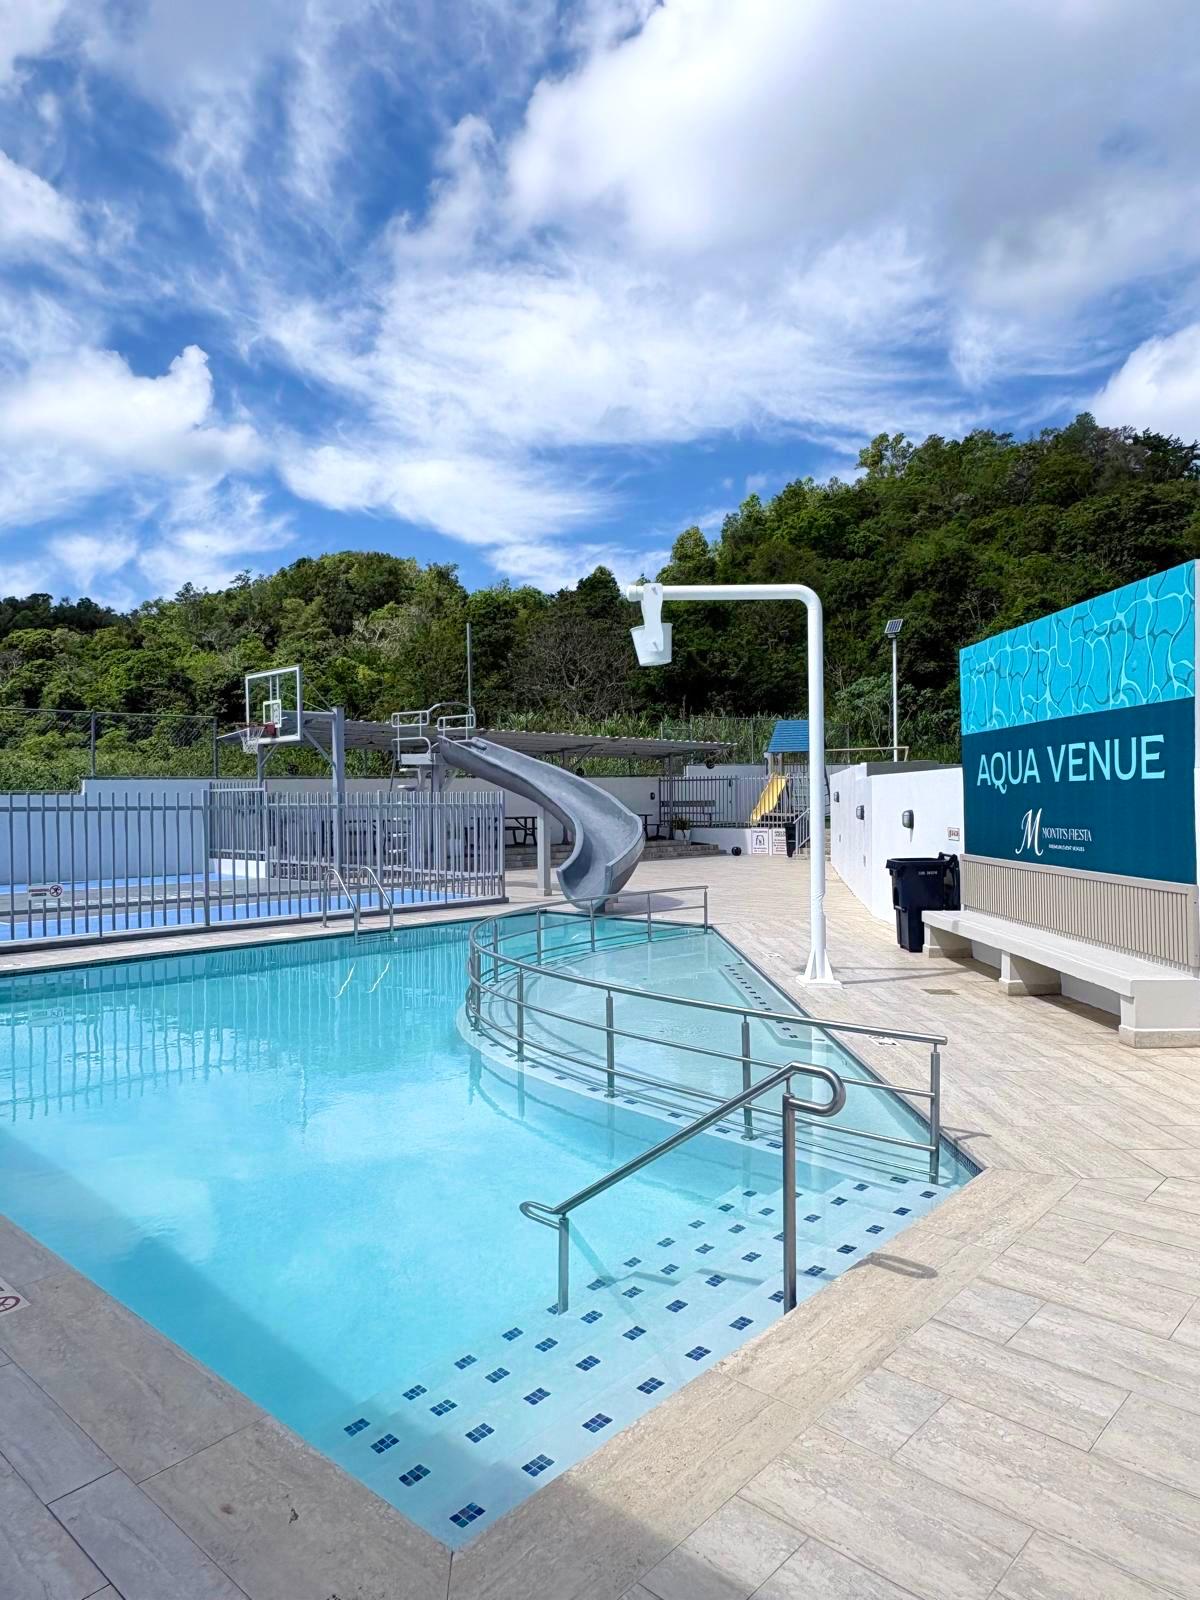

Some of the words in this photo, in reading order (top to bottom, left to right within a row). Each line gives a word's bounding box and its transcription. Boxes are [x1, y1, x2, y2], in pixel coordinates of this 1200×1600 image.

[976, 748, 1041, 794] AQUA
[1047, 734, 1165, 782] VENUE
[1015, 808, 1044, 856] M
[1068, 828, 1092, 842] FIESTA
